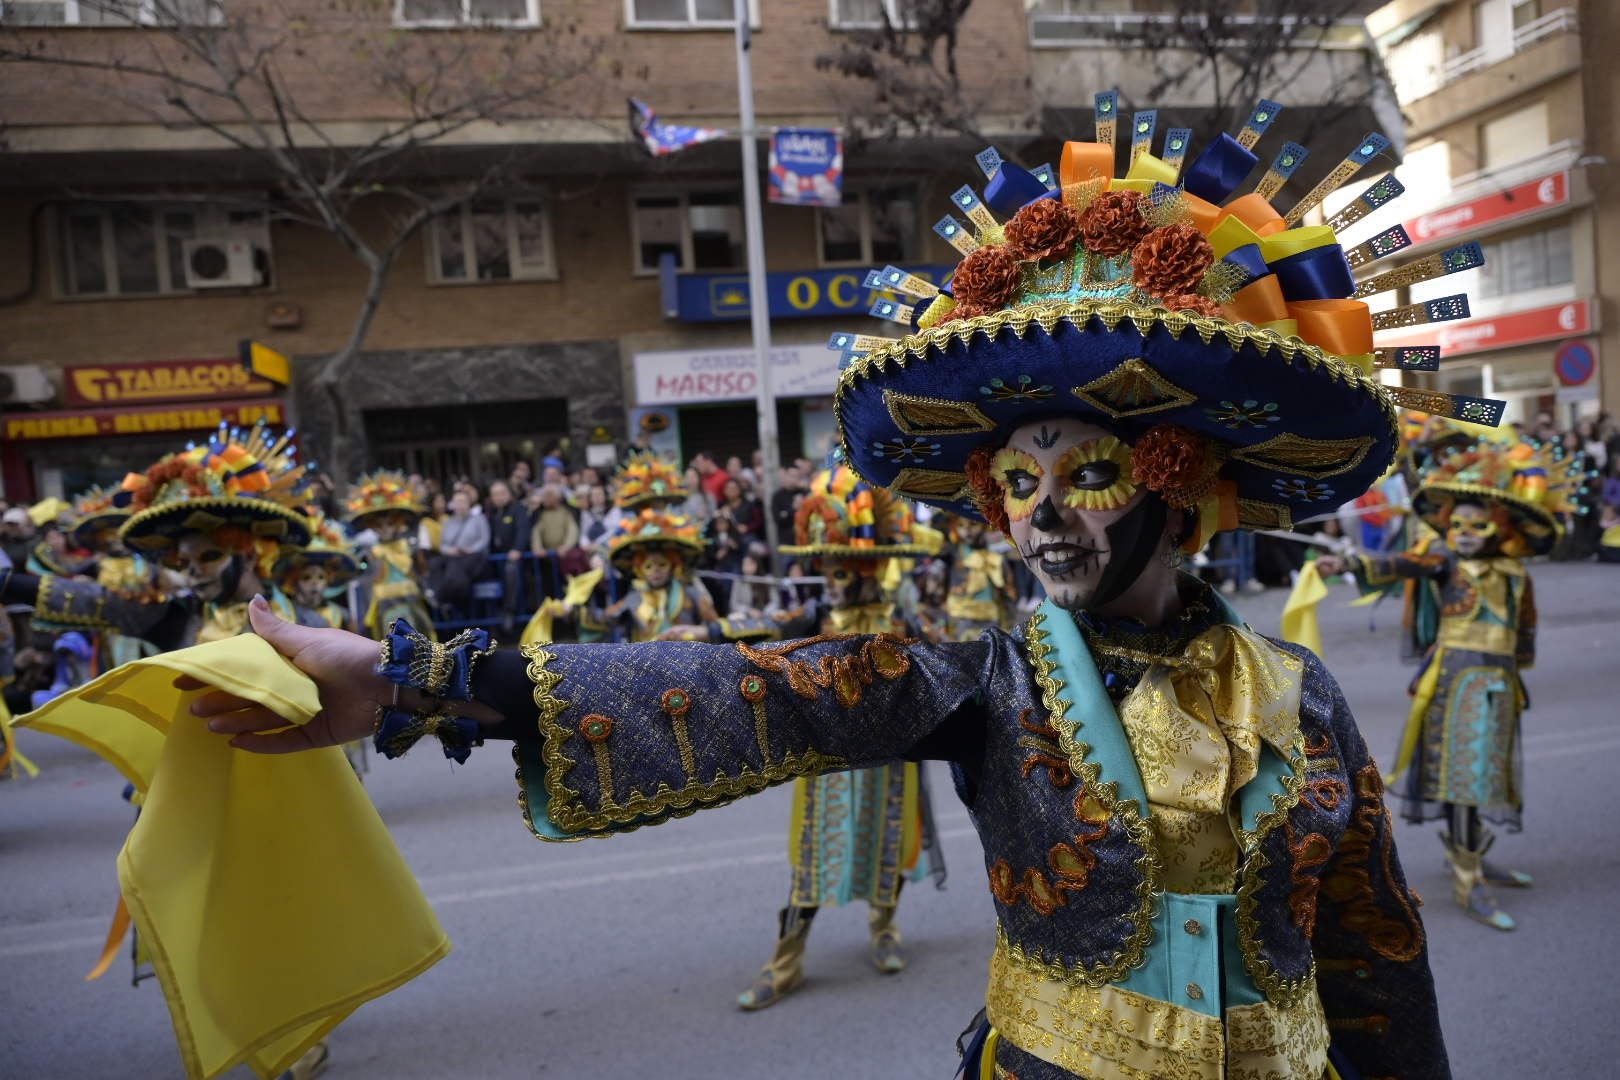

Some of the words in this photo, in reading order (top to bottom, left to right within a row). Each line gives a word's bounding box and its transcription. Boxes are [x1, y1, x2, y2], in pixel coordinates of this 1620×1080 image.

[116, 364, 250, 391] TABACOS
[655, 371, 759, 398] MARISO
[7, 415, 97, 439] PRENSA
[115, 409, 223, 433] REVISTAS
